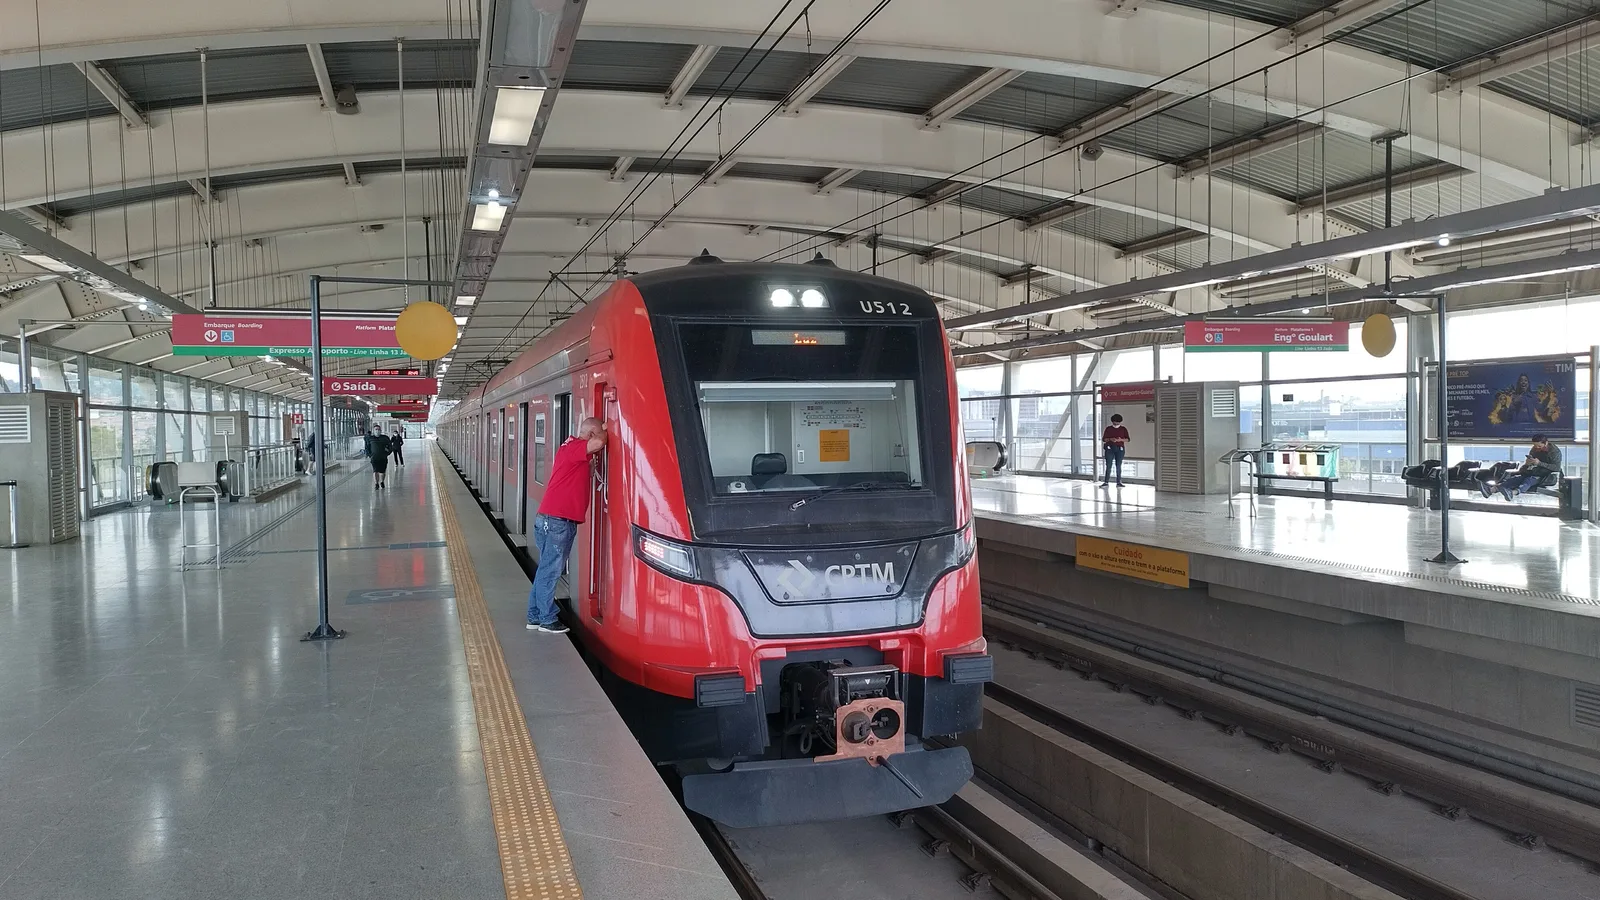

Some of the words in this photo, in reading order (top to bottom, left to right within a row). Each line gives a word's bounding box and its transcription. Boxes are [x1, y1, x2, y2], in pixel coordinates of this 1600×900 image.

[860, 300, 912, 316] U512
[1298, 333, 1333, 342] Goulart
[269, 347, 305, 356] Expresso
[307, 347, 349, 356] Aoporto
[1555, 363, 1573, 373] TIM
[342, 381, 376, 391] Saída
[293, 415, 303, 424] H
[1114, 546, 1142, 560] Cuidado
[1136, 560, 1147, 568] trem
[1156, 564, 1186, 577] plataforma
[824, 562, 895, 586] CPTM
